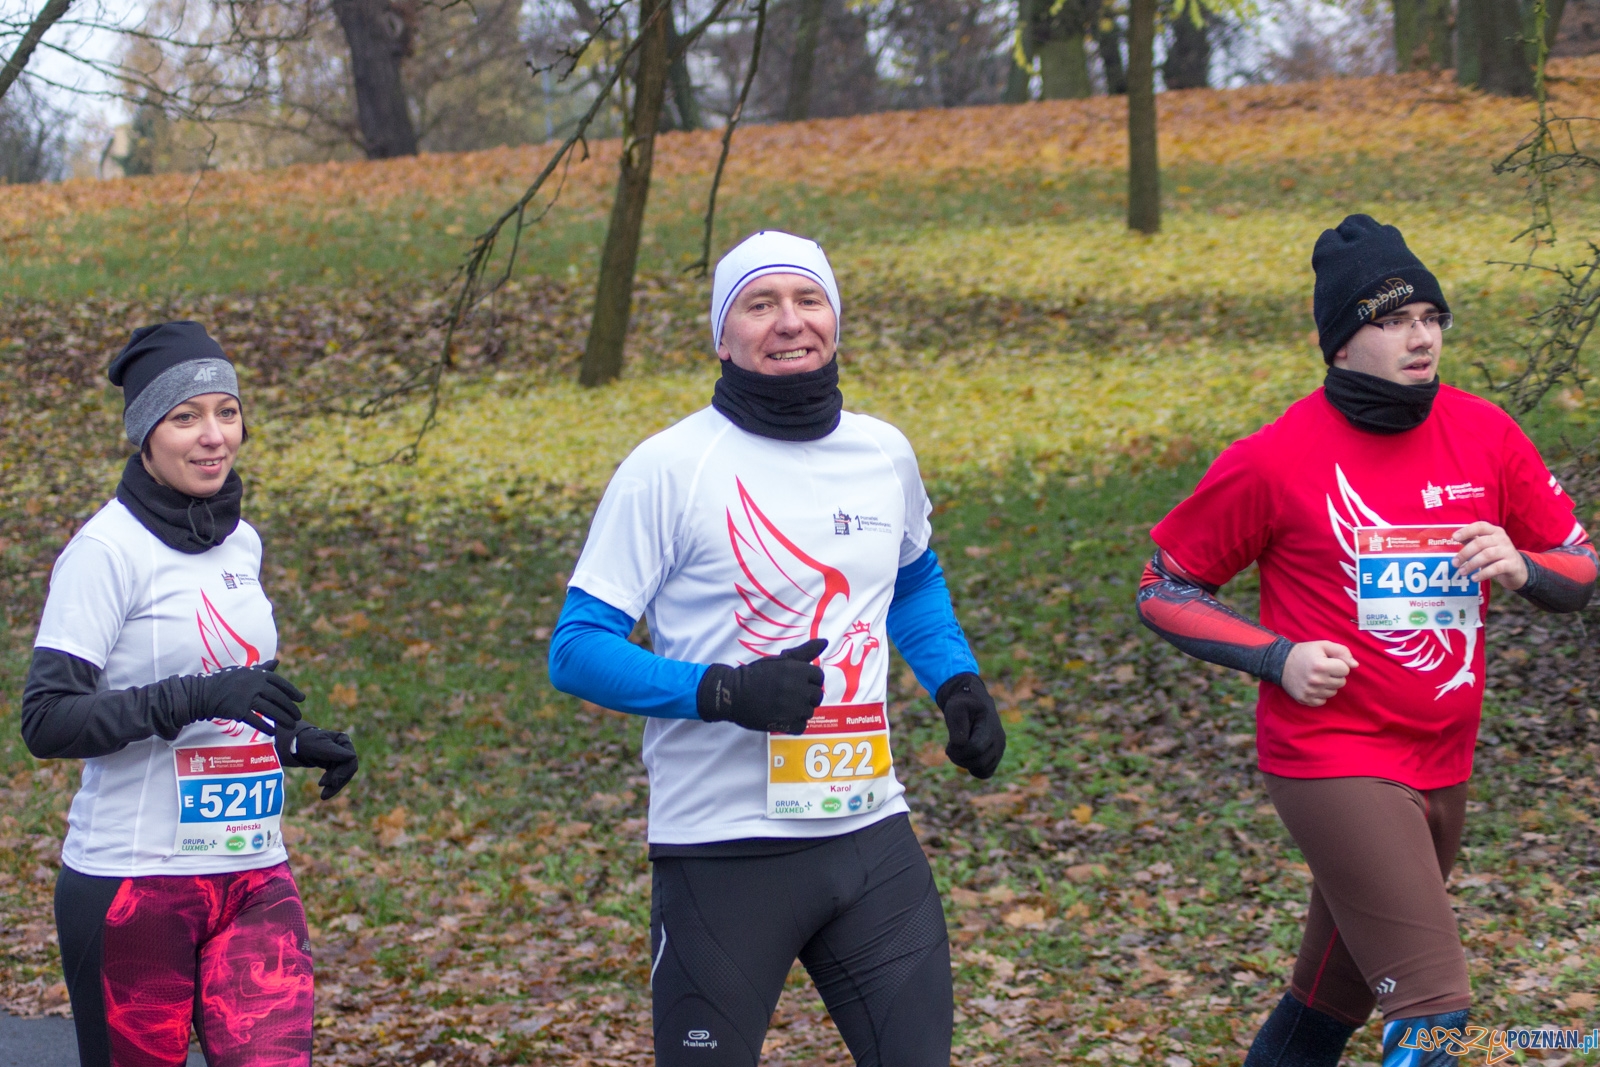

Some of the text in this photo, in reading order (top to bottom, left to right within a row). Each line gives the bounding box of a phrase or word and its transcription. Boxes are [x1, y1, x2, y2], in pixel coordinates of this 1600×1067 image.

[1357, 284, 1414, 320] fishbone
[193, 366, 218, 381] 4F
[854, 515, 863, 530] 1
[1386, 537, 1393, 549] 1
[1362, 561, 1470, 594] E 4644
[1409, 600, 1446, 608] Wojciech
[208, 756, 215, 769] 1
[773, 741, 874, 779] D 622
[830, 784, 852, 793] Karol
[184, 779, 278, 819] E 5217
[225, 823, 262, 834] Agnieszka
[181, 844, 209, 852] LUXMED
[682, 1040, 718, 1050] Kalenji
